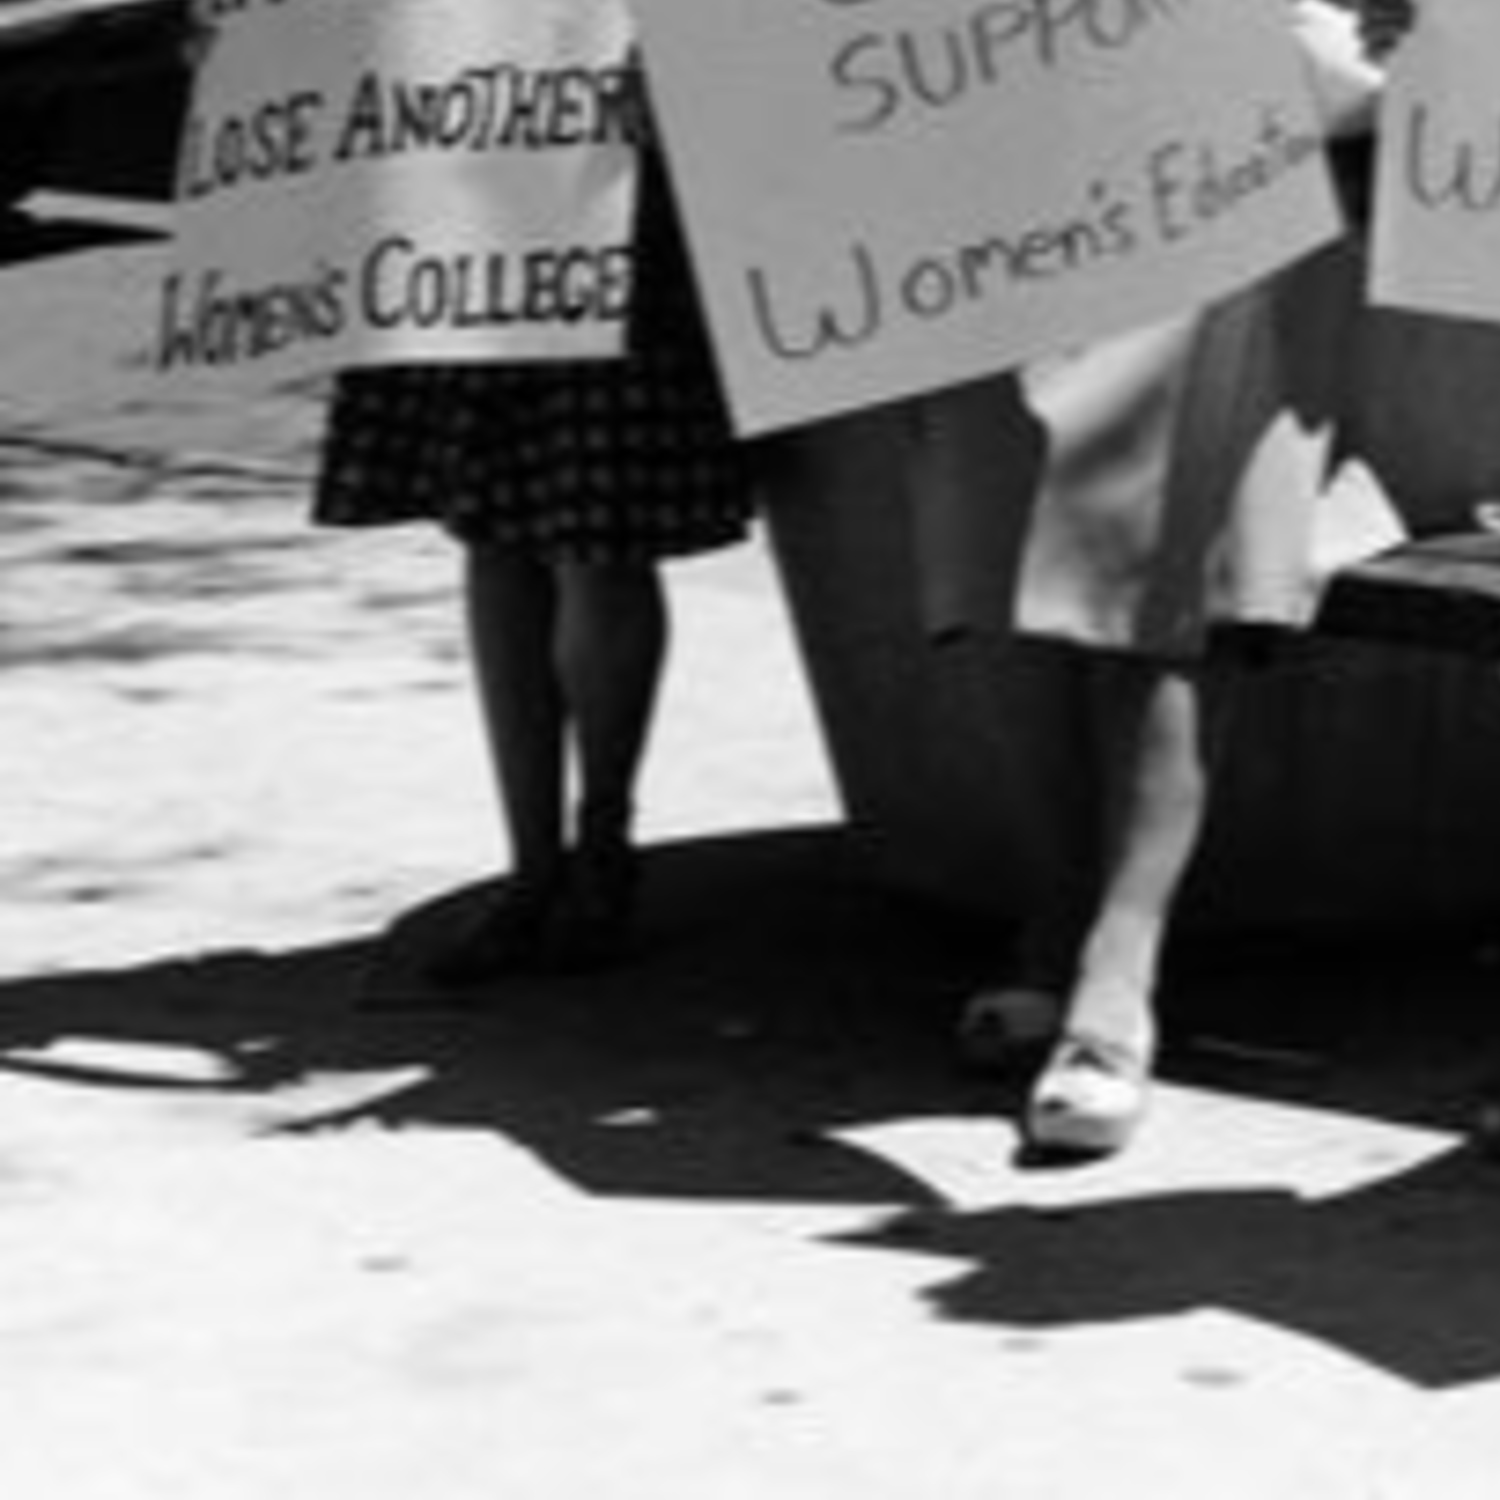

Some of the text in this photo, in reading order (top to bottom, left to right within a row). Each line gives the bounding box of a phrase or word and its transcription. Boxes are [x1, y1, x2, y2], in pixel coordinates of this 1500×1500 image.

[331, 60, 642, 163] ANOTHER
[358, 235, 637, 331] COLLEGE
[744, 180, 1140, 361] Women's
